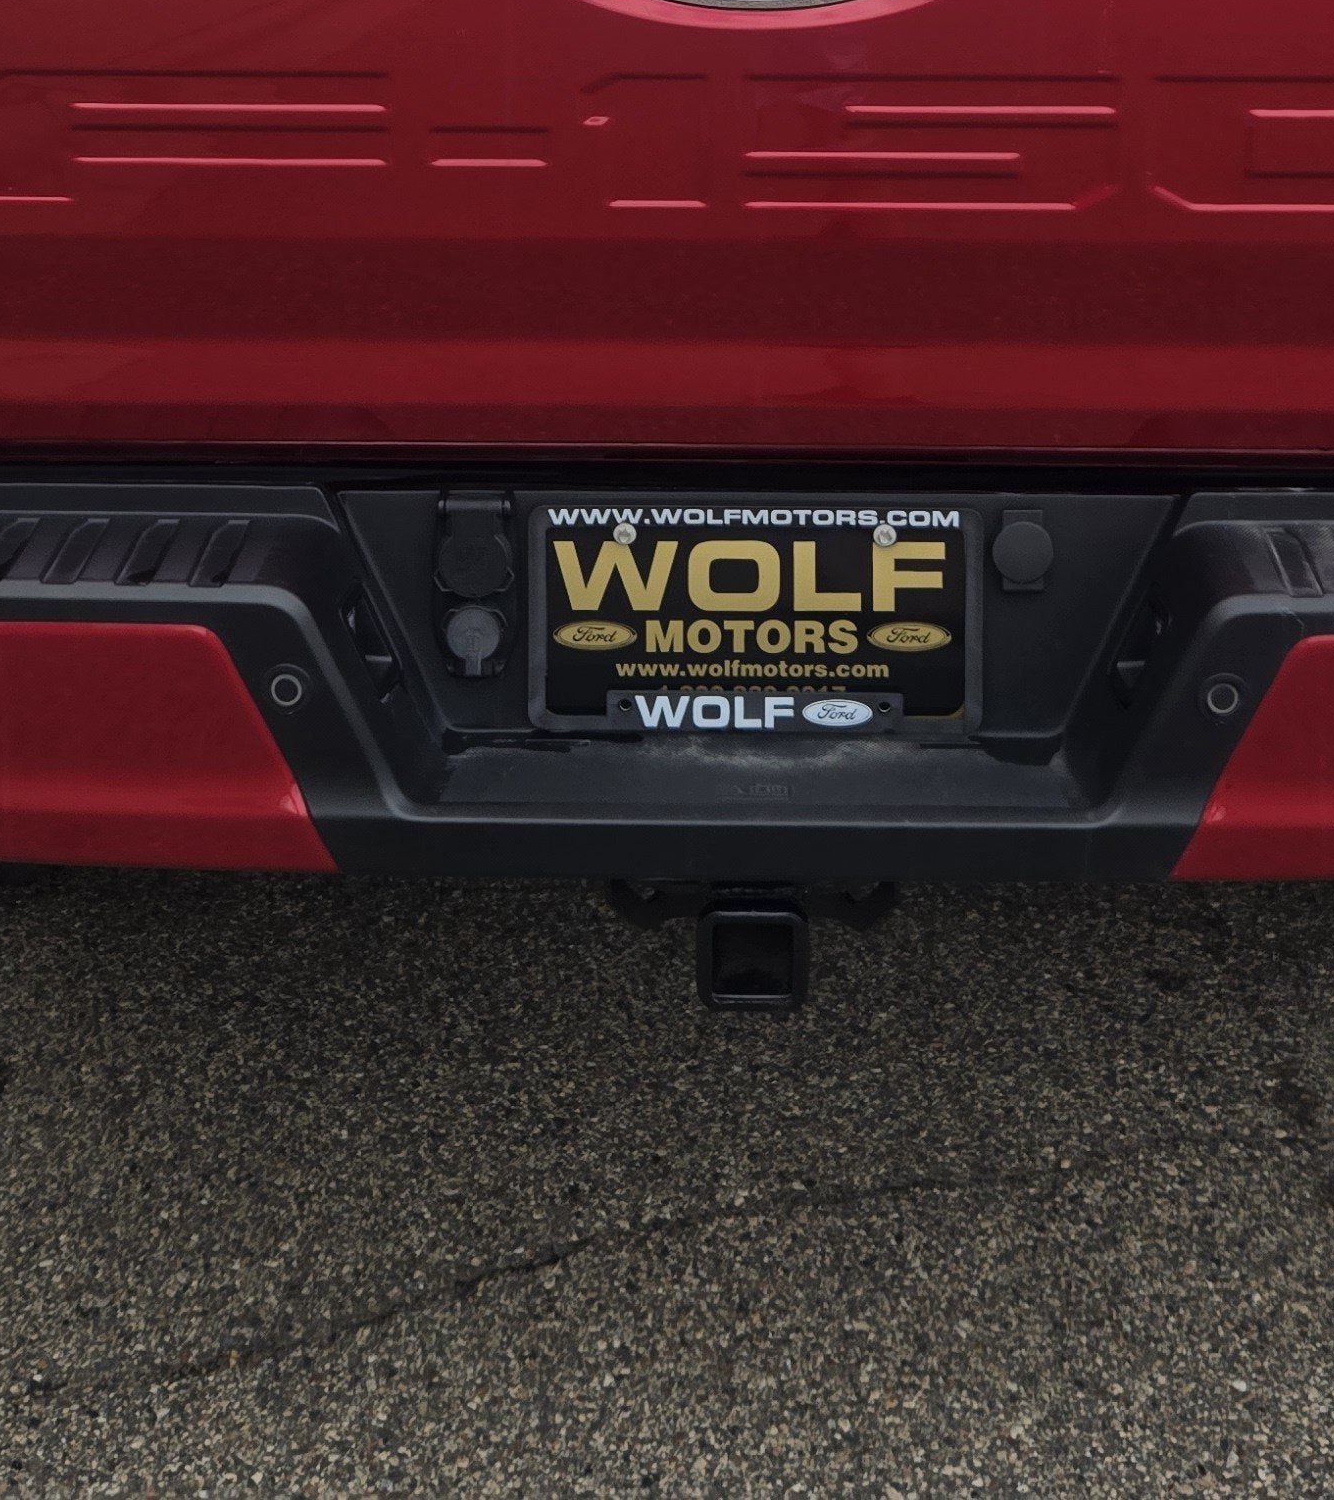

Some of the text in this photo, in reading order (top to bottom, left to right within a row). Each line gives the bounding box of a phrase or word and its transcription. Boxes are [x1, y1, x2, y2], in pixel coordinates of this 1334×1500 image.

[548, 508, 960, 528] WWW.WOLFMOTORS.COM
[553, 540, 946, 612] WOLF
[573, 626, 617, 644] Ford
[645, 620, 859, 654] MOTORS
[886, 626, 931, 645] Ford
[615, 660, 889, 678] www.wolfmotors.com
[634, 695, 795, 729] WOLF
[817, 703, 857, 721] Ford
